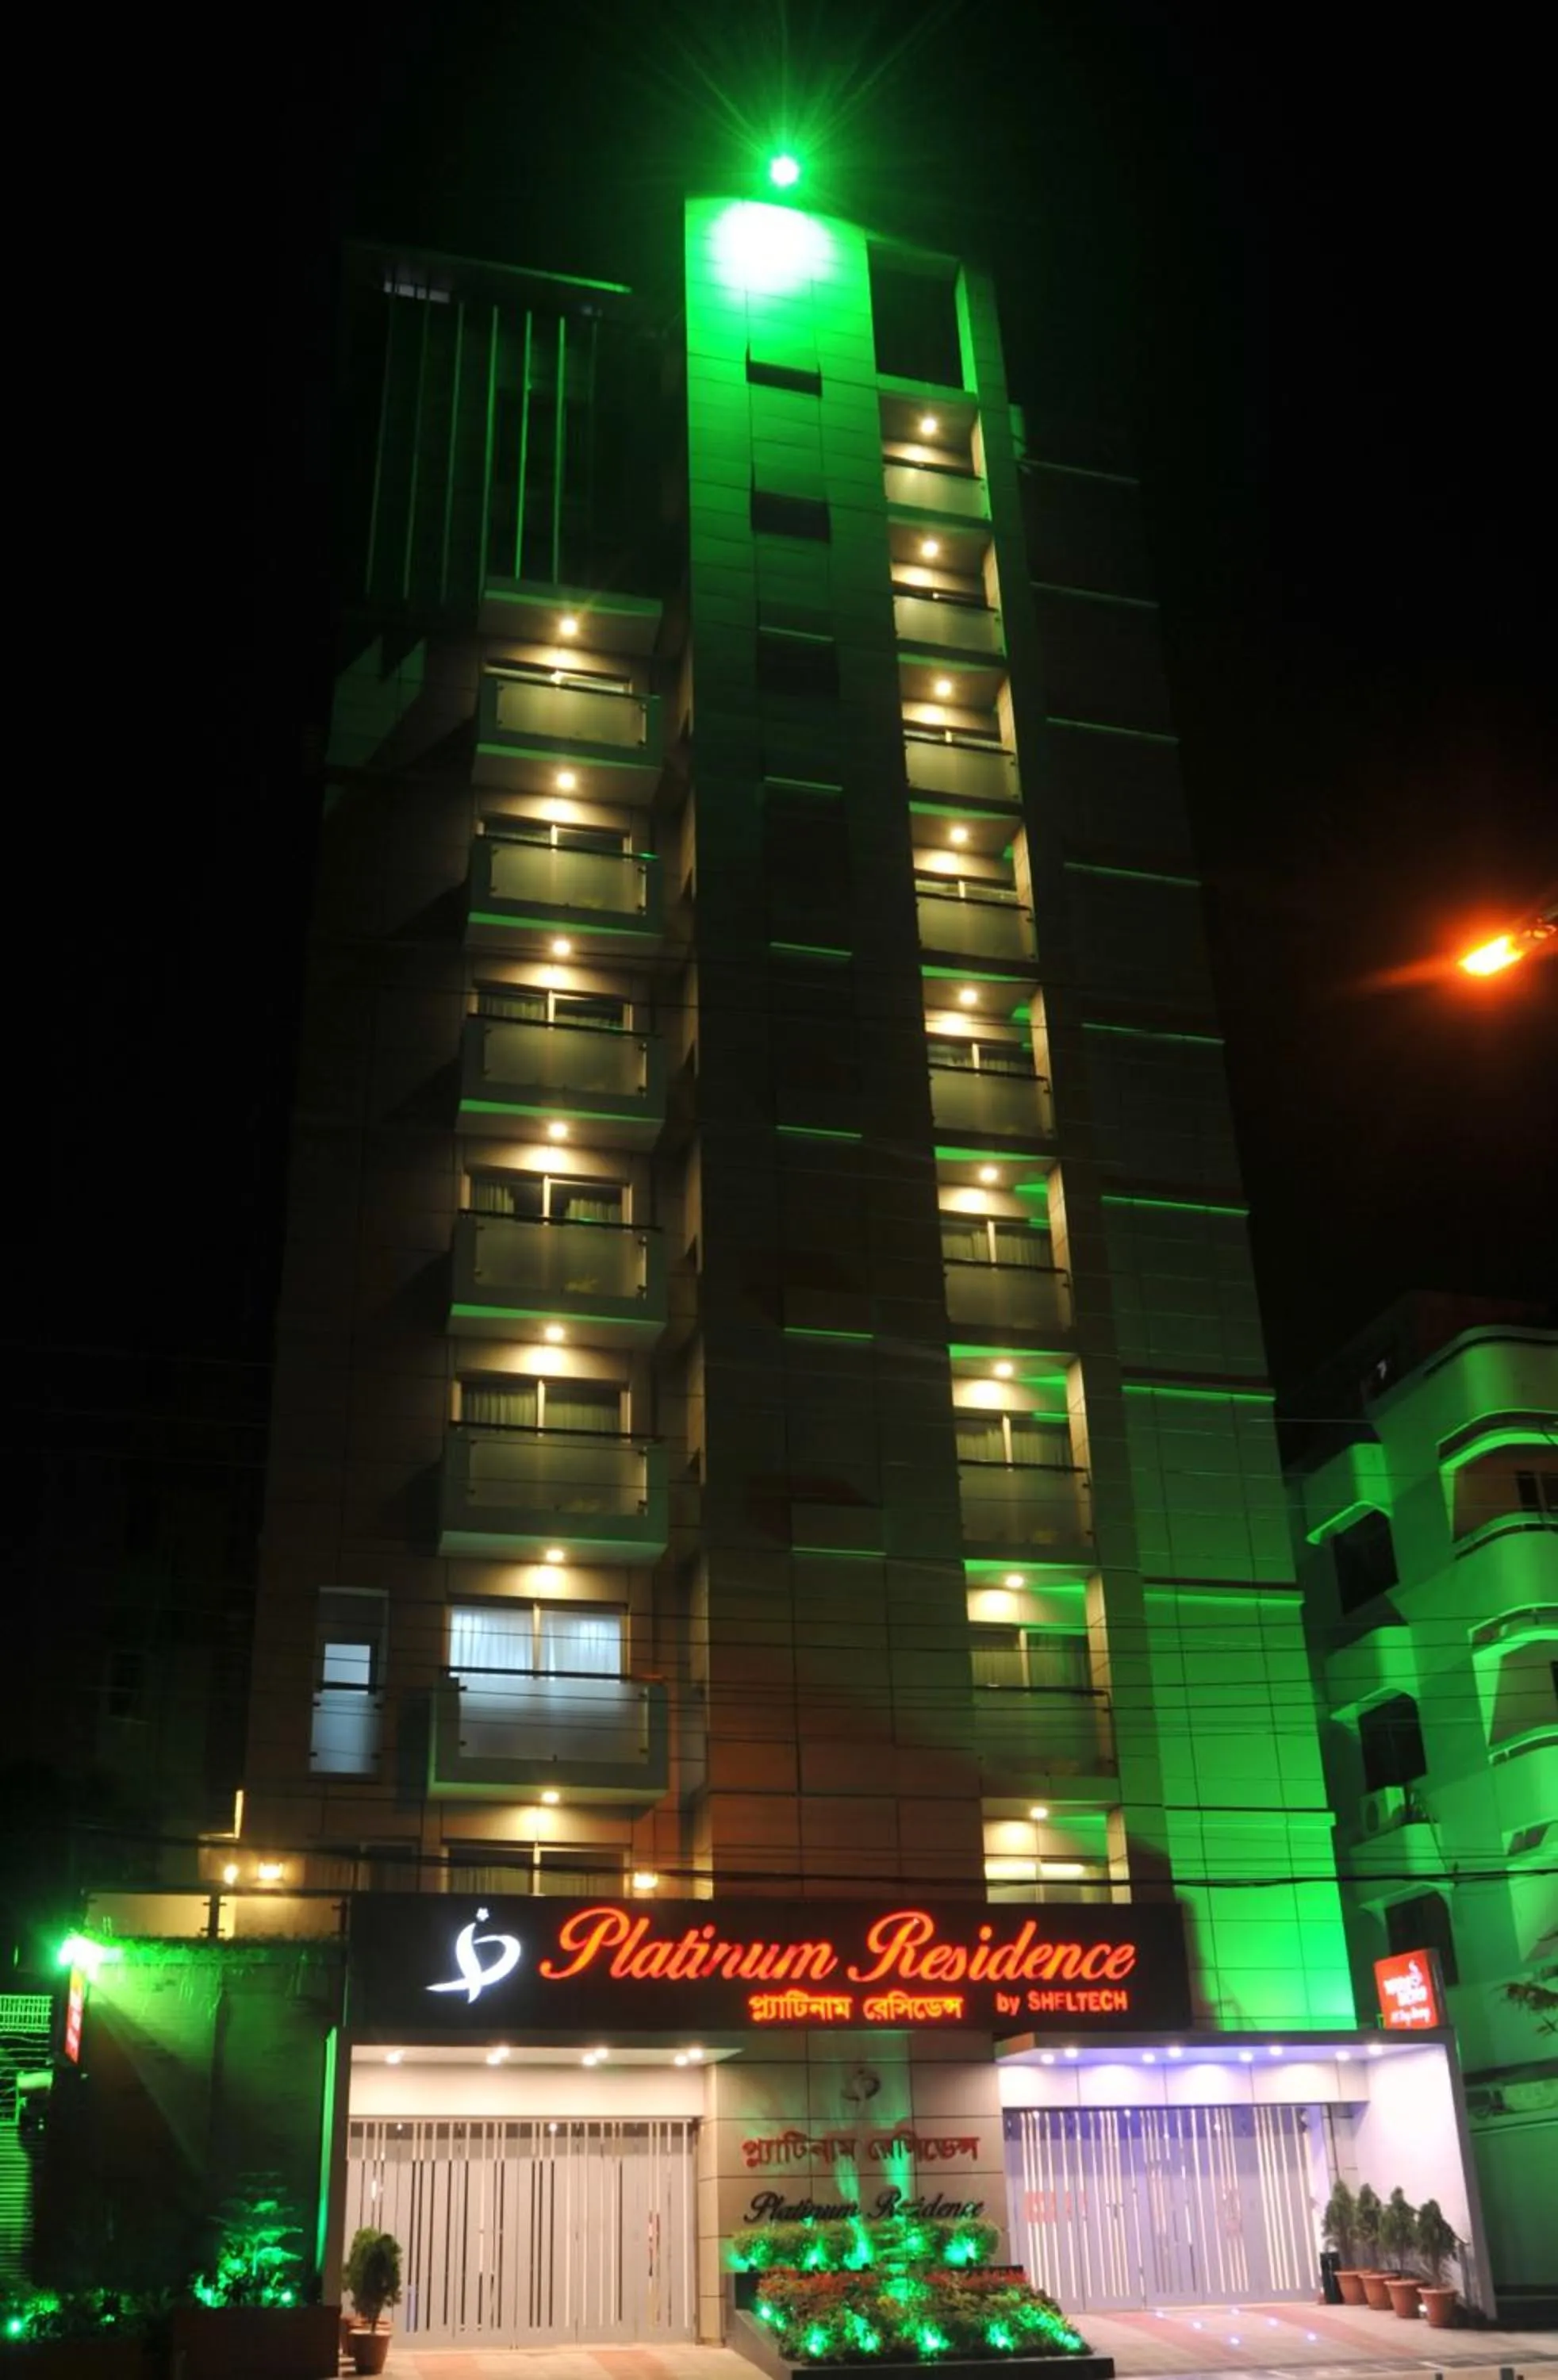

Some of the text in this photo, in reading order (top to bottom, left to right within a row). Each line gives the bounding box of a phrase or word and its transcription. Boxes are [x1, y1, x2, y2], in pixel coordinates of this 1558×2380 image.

[539, 1906, 1136, 1982] Platinum Residence
[862, 1989, 965, 2021] রেসিডেন্স
[996, 1992, 1021, 2016] by
